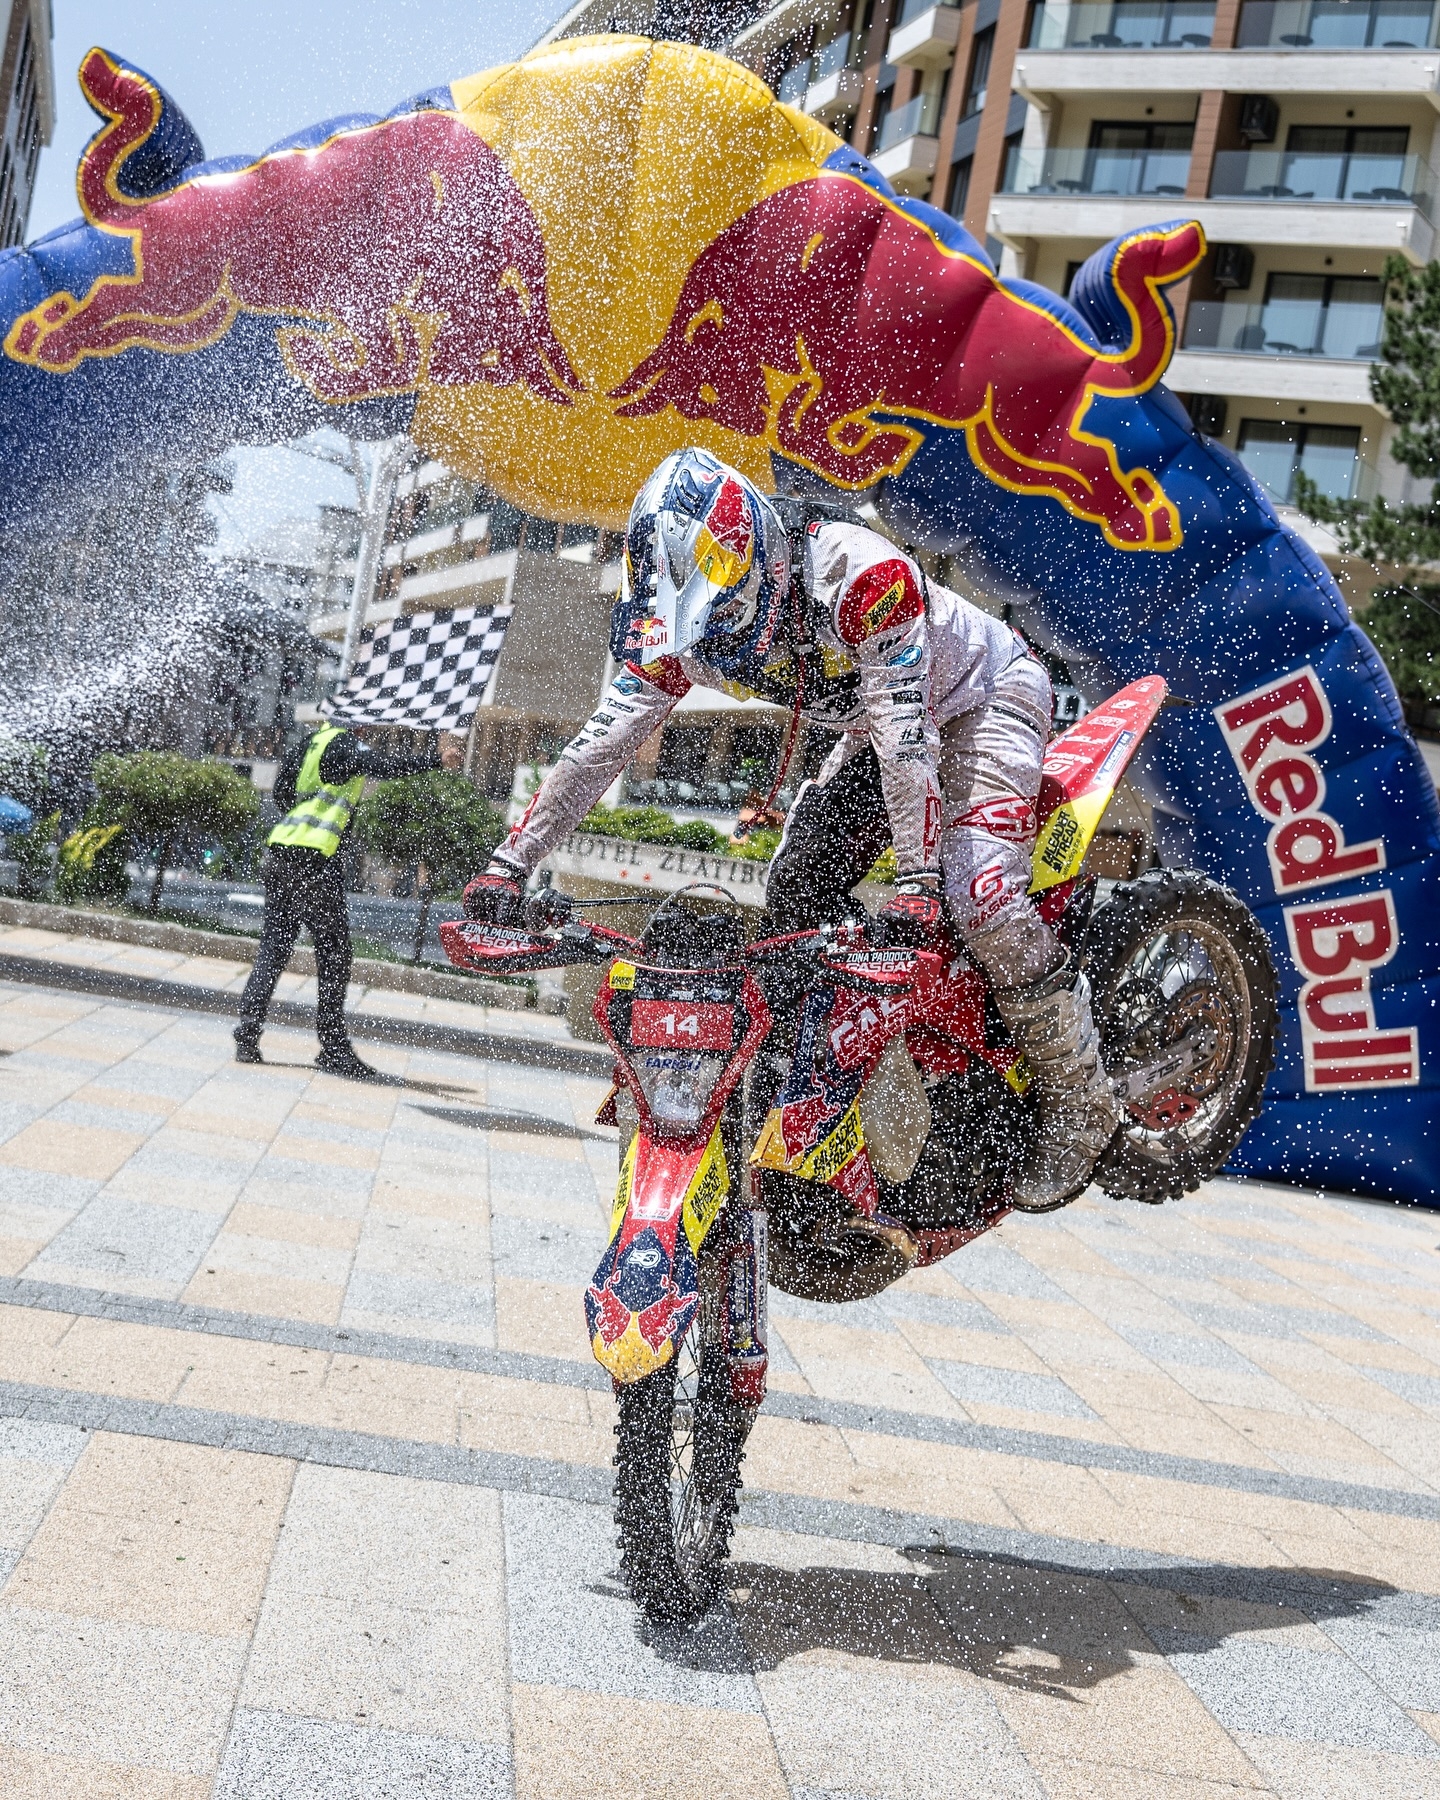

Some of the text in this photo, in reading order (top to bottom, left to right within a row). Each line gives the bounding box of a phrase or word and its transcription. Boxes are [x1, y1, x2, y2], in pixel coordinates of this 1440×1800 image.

[624, 631, 668, 650] Red Bull
[1055, 819, 1078, 858] TREAD
[1216, 668, 1417, 1090] Red Bull
[464, 923, 532, 942] ZONA PADDOCK
[845, 961, 917, 972] GASGAS
[846, 951, 914, 963] ZONA PADDOCK
[659, 1013, 699, 1036] 14
